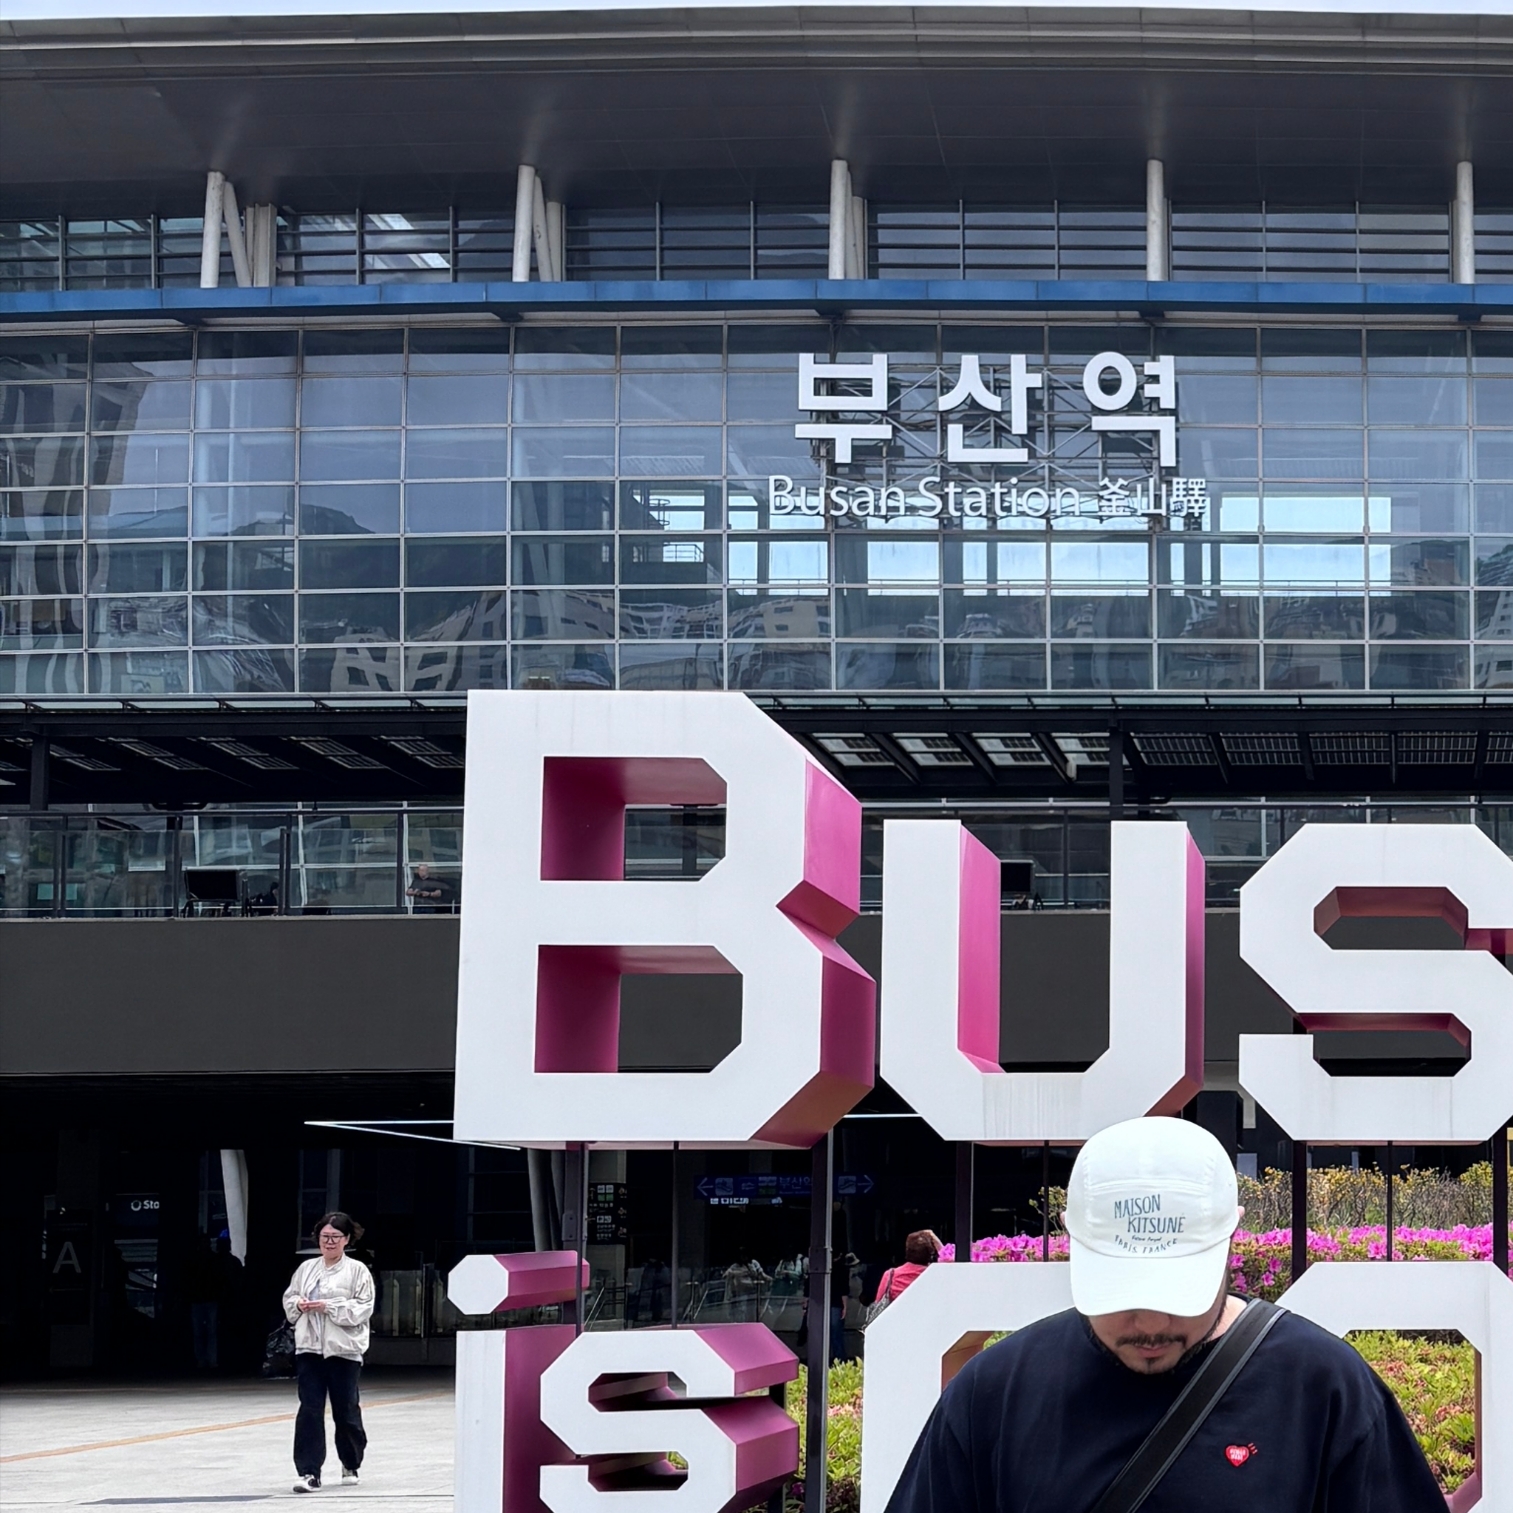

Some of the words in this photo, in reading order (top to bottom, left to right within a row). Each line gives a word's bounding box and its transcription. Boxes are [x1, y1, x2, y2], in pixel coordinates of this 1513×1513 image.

[795, 351, 1177, 468] 부산역
[768, 474, 906, 518] Busan
[918, 476, 1081, 518] Station
[1114, 1193, 1161, 1219] MAISON
[52, 1240, 82, 1274] A
